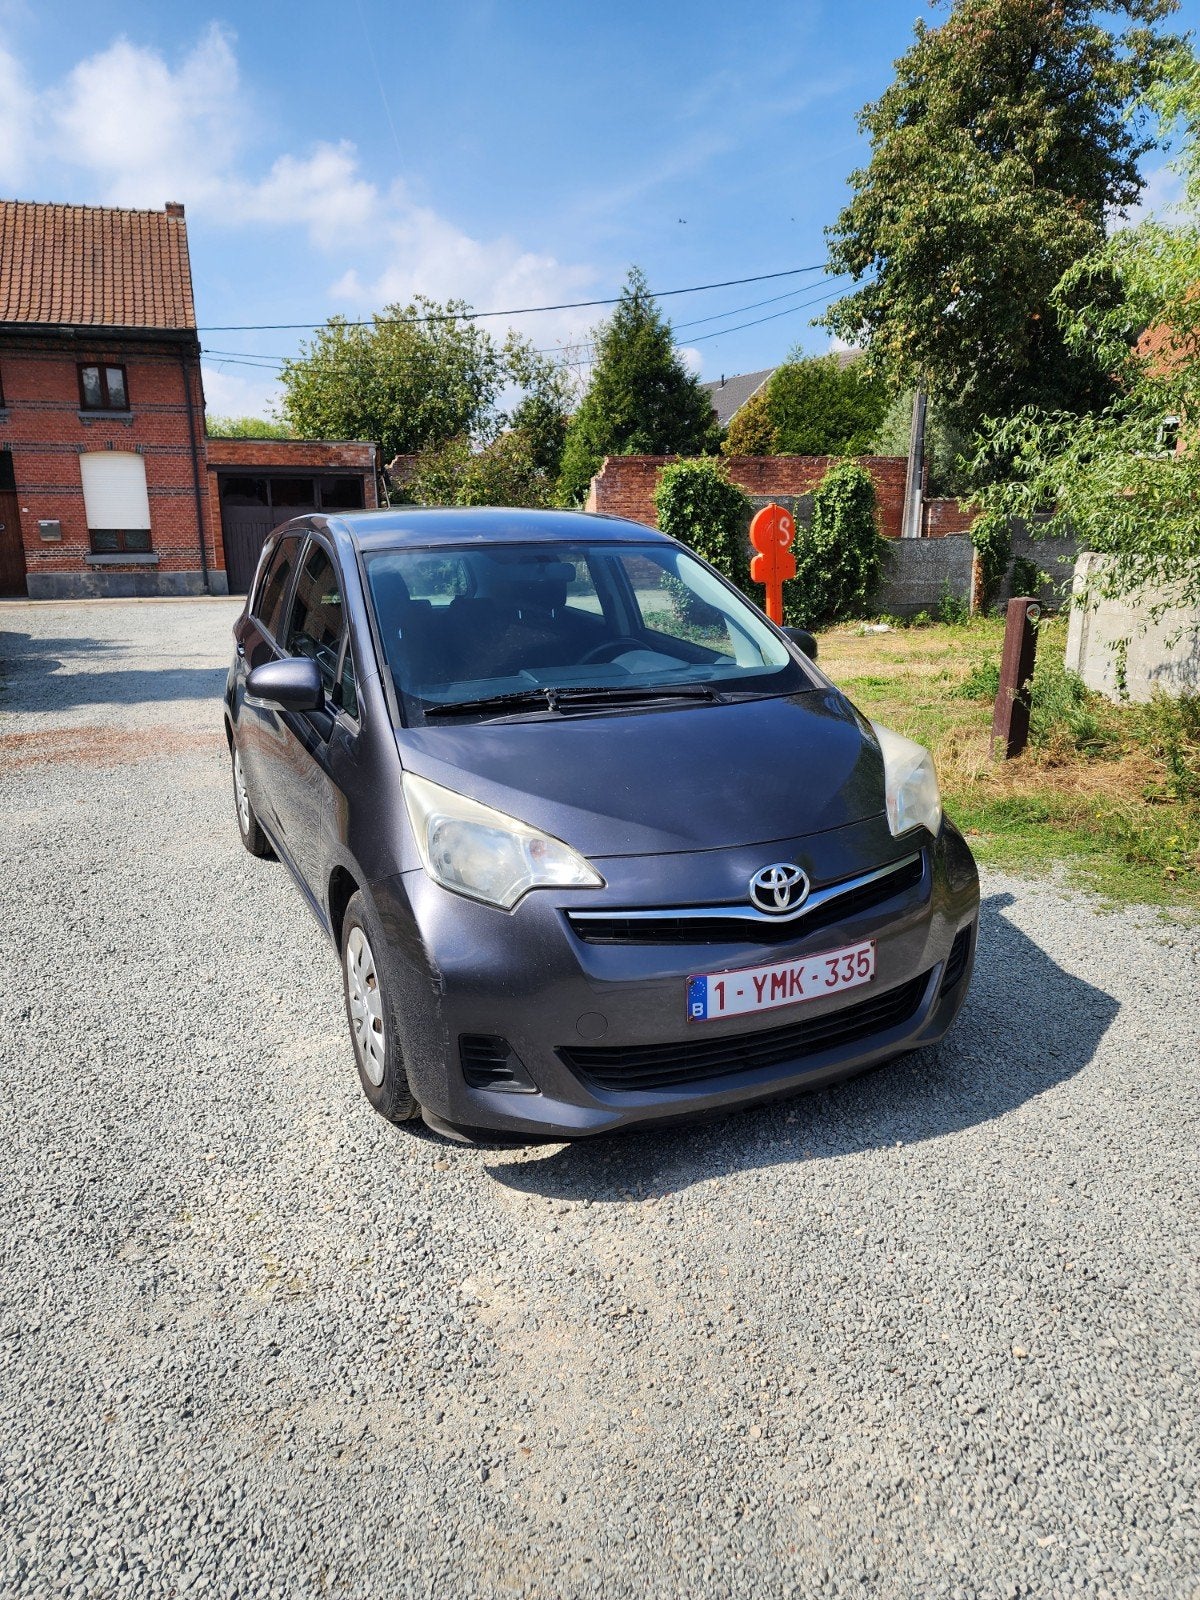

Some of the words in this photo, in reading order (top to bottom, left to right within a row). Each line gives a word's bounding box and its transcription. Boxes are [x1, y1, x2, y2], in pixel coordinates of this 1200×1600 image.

[779, 516, 791, 546] S
[714, 948, 871, 1011] 1-YMK-335
[692, 1002, 704, 1017] B
